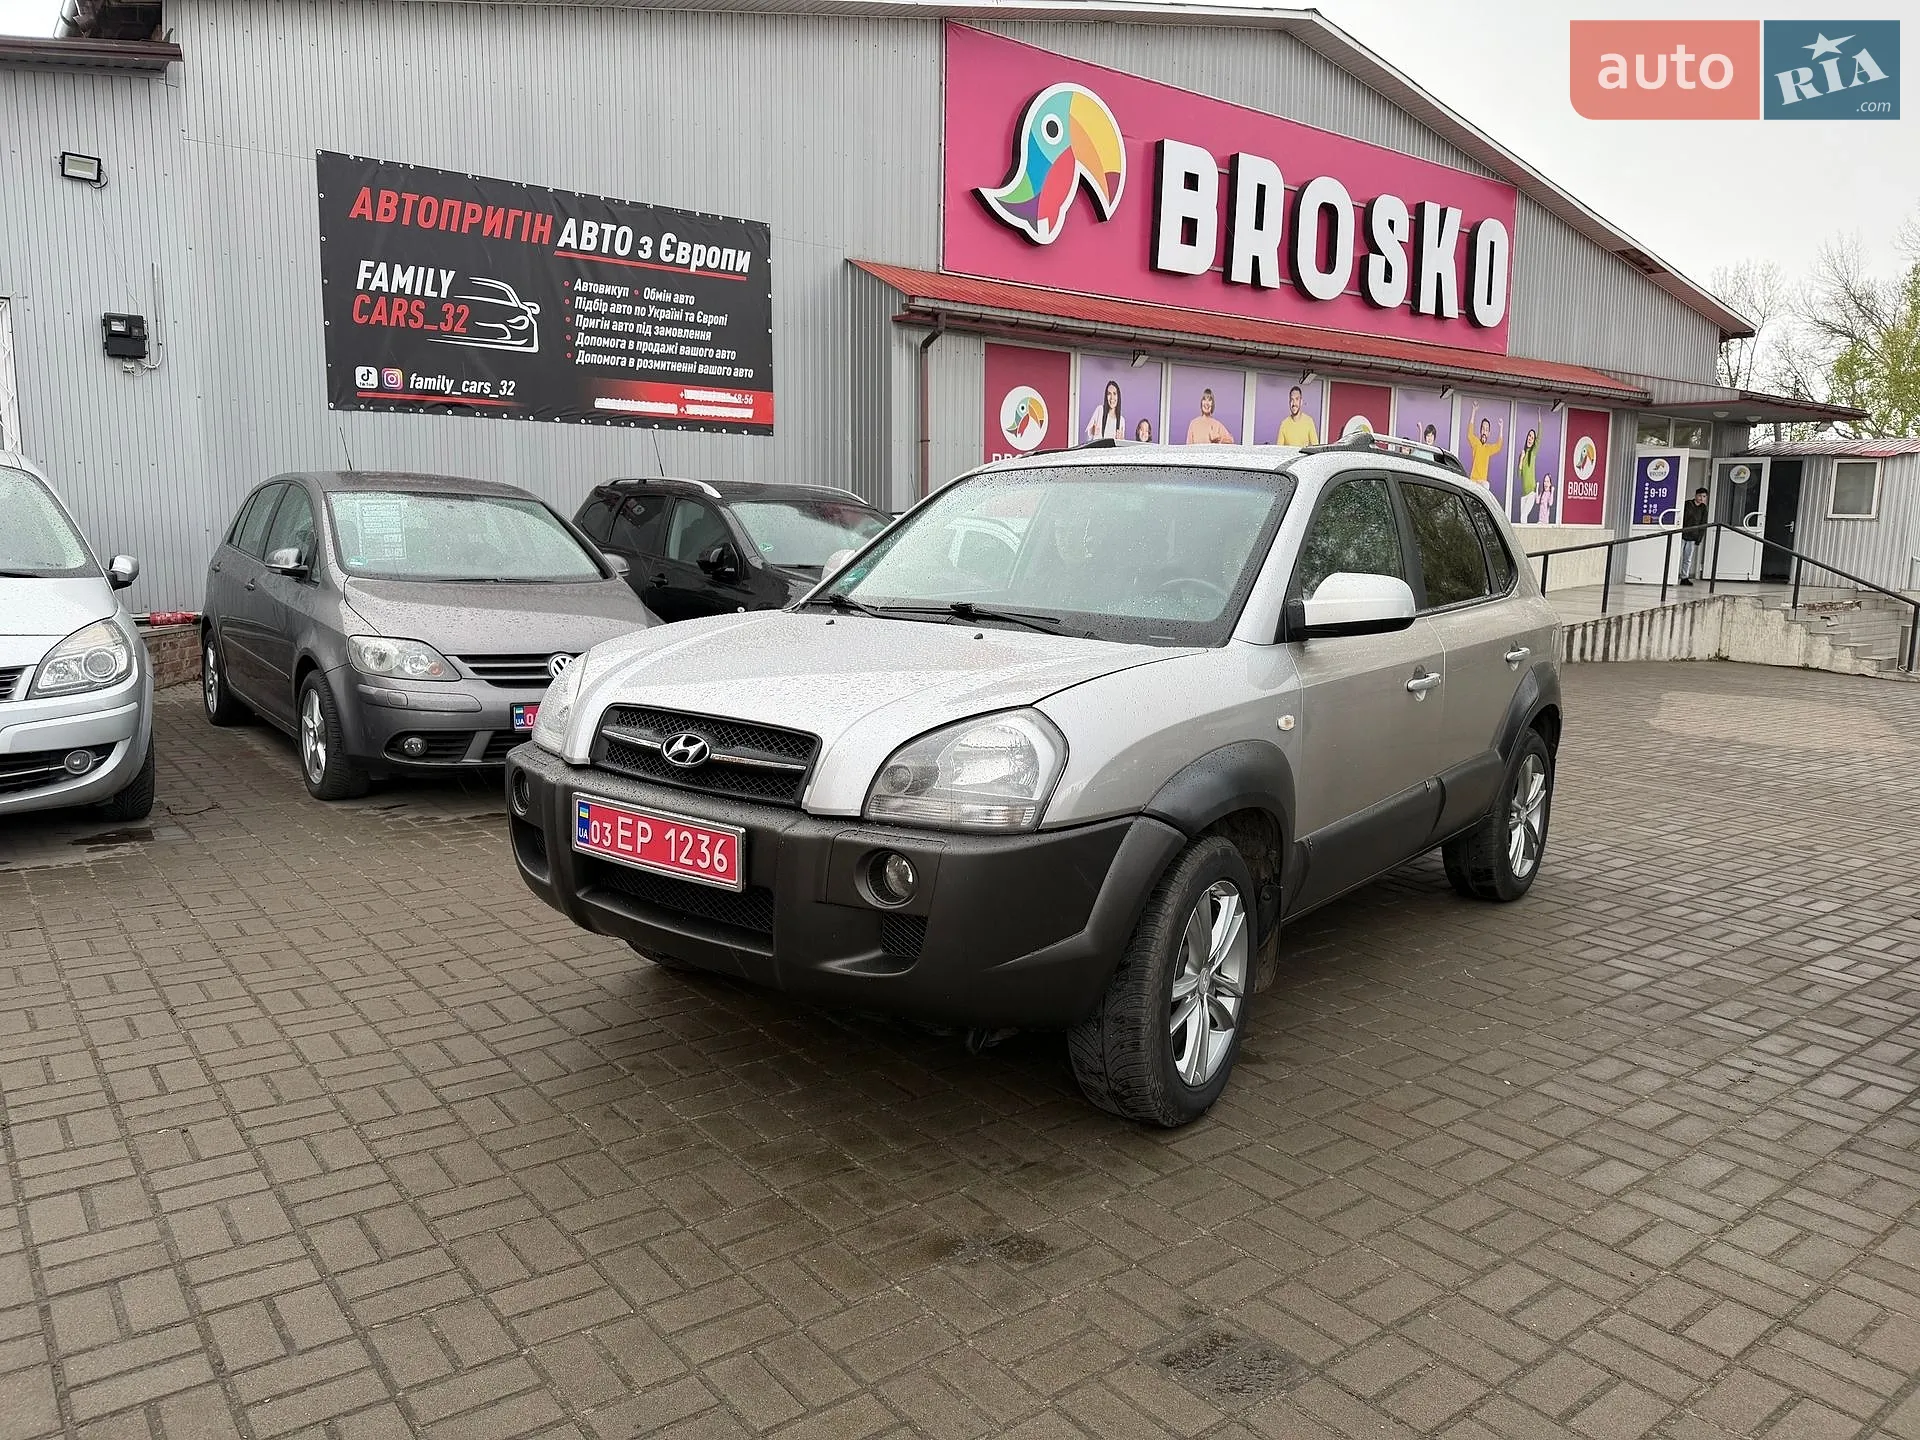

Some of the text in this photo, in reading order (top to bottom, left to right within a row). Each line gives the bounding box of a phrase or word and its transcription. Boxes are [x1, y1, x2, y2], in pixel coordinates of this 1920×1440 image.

[349, 186, 751, 273] АВТОПРИГІН АВТО з Європи
[1153, 138, 1509, 329] BROSKO
[356, 260, 456, 298] FAMILY
[573, 278, 695, 305] Автовикуп Обмін авто
[352, 294, 470, 333] CARS_32
[574, 296, 728, 327] Підбір авто по Україні та Європі
[575, 314, 712, 341] Пригін авто під замовлення
[575, 332, 736, 361] Допомога в продажі вашого авто
[575, 349, 754, 379] Допомога в розмитненні вашого авто
[409, 373, 516, 398] family_cars_32
[1568, 481, 1598, 497] BROSKO
[1650, 487, 1667, 498] 9-19
[578, 827, 589, 840] UA
[664, 828, 728, 873] 1236
